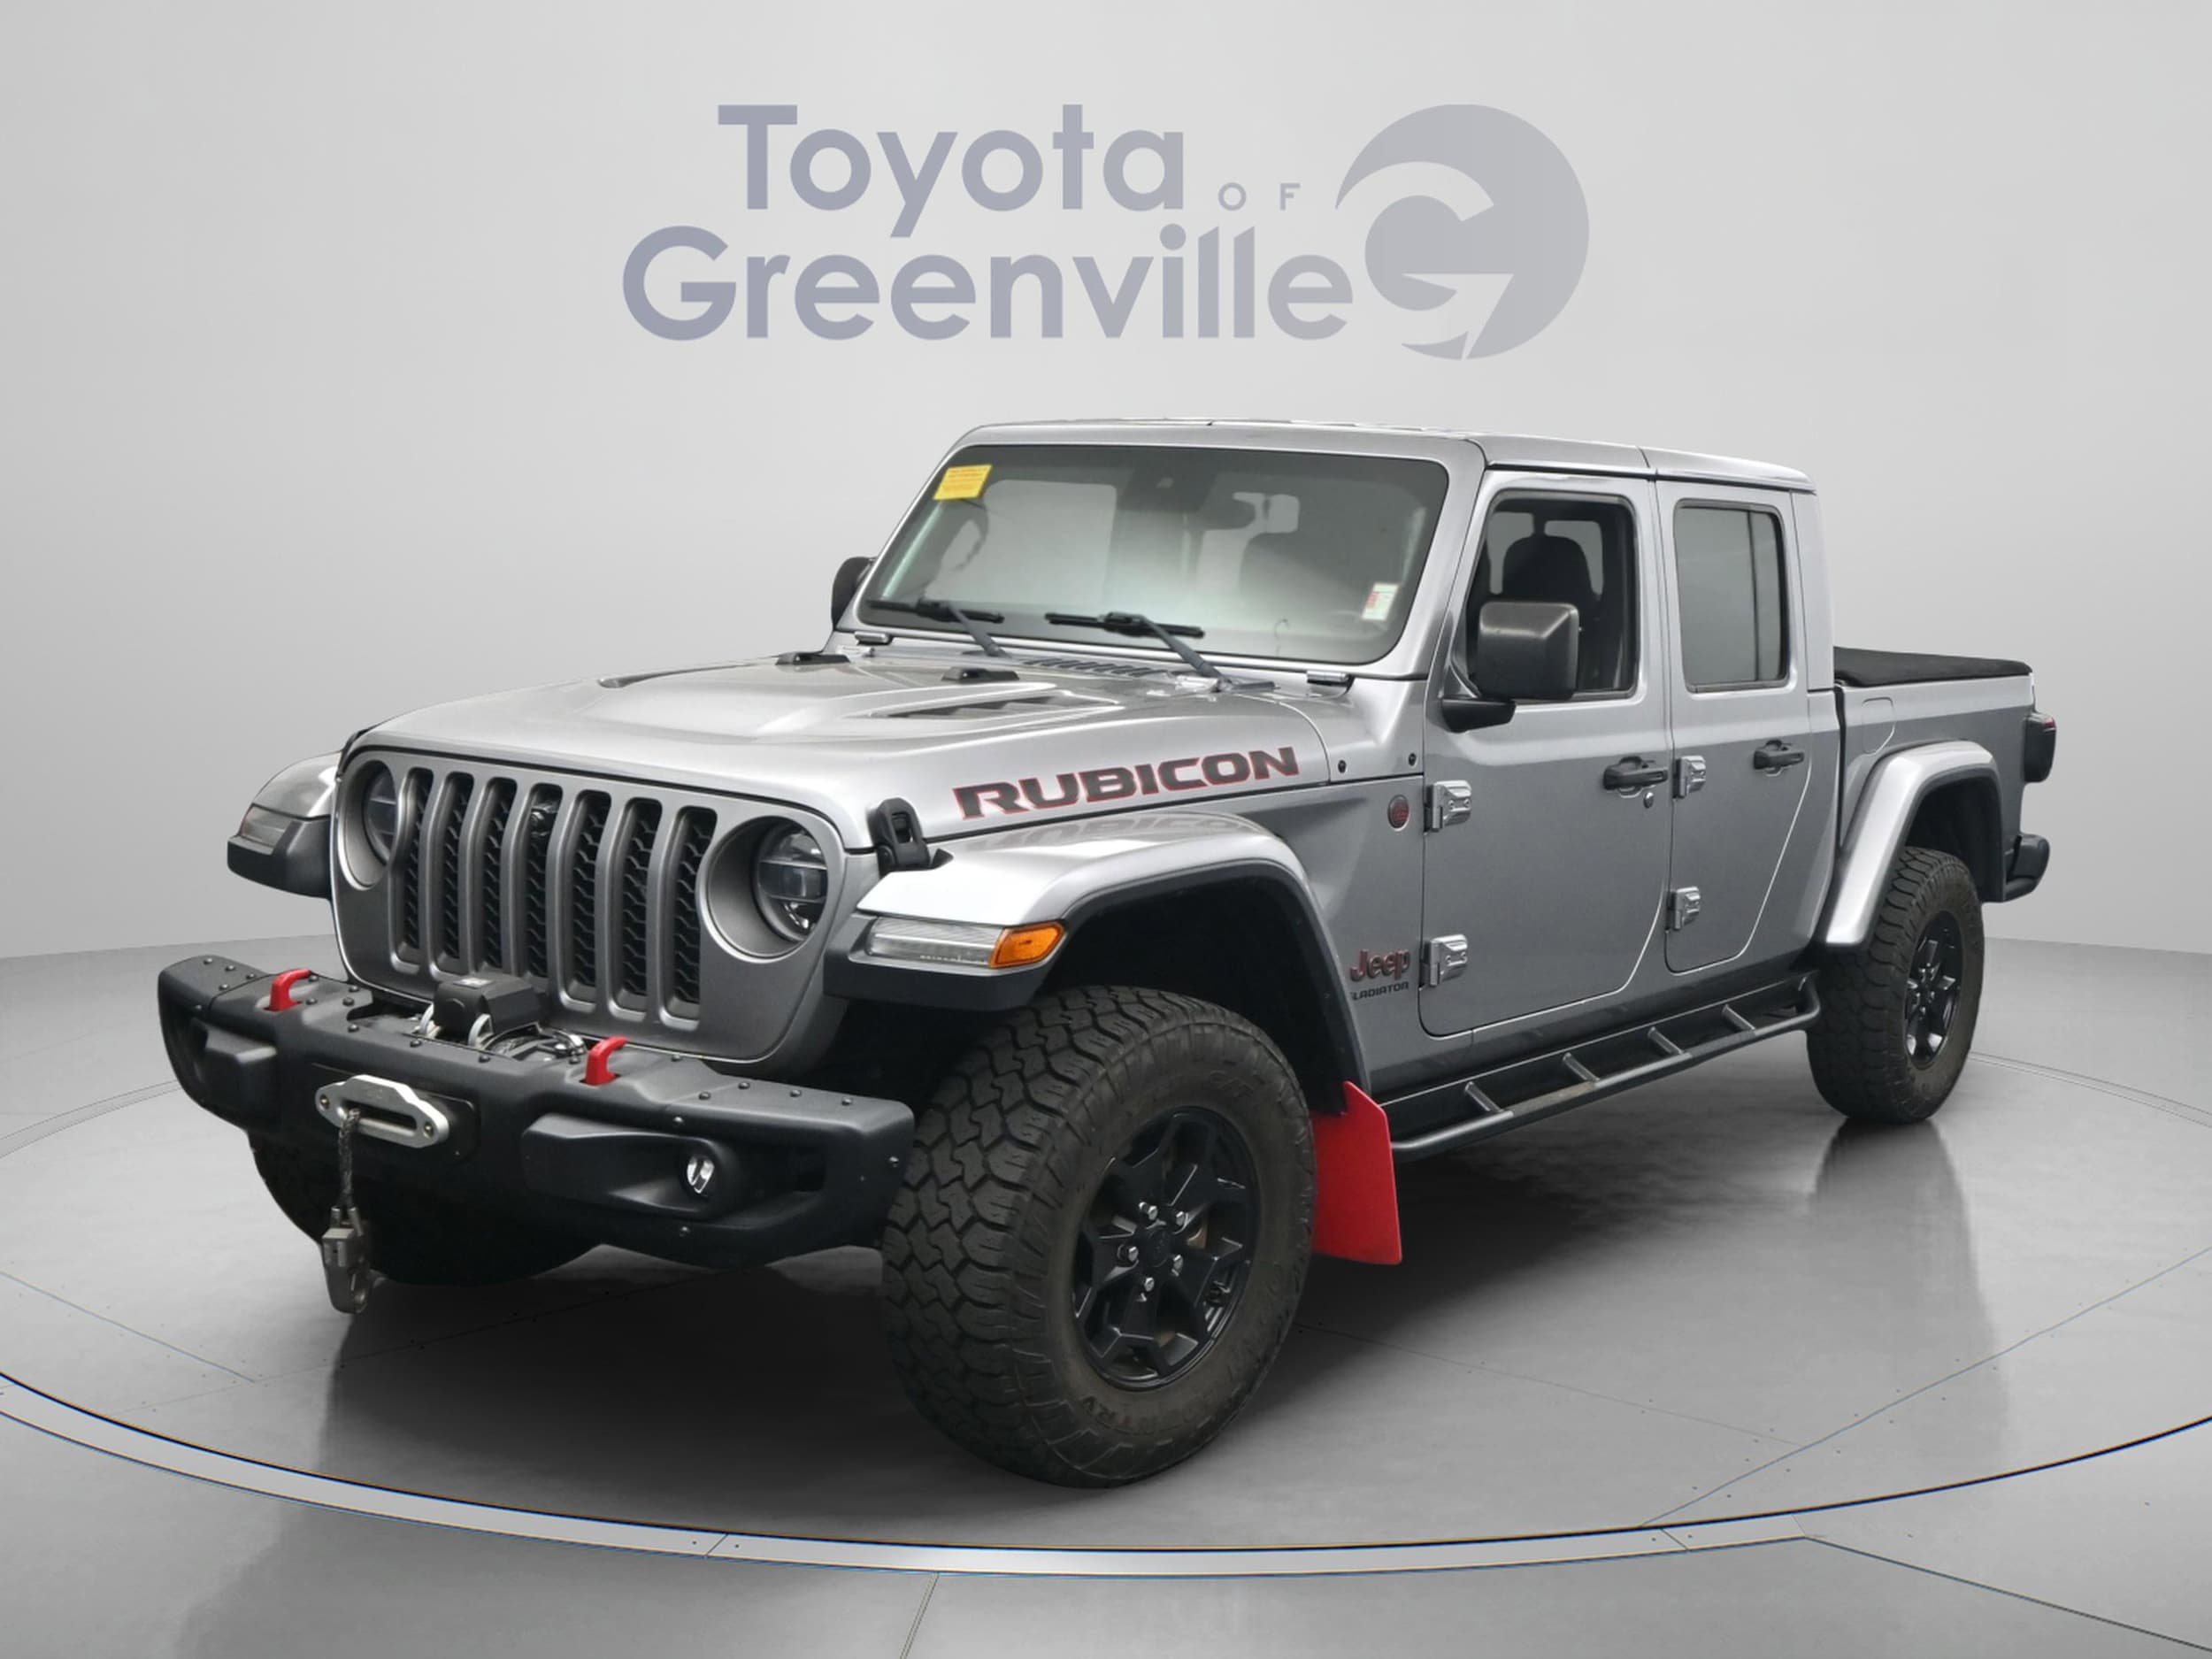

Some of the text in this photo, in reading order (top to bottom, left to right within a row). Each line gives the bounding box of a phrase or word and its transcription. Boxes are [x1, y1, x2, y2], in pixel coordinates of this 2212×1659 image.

[718, 104, 1301, 237] Toyota OF
[623, 224, 1352, 341] Greenville
[952, 746, 1299, 820] RUBICON
[1349, 949, 1410, 981] Jeep
